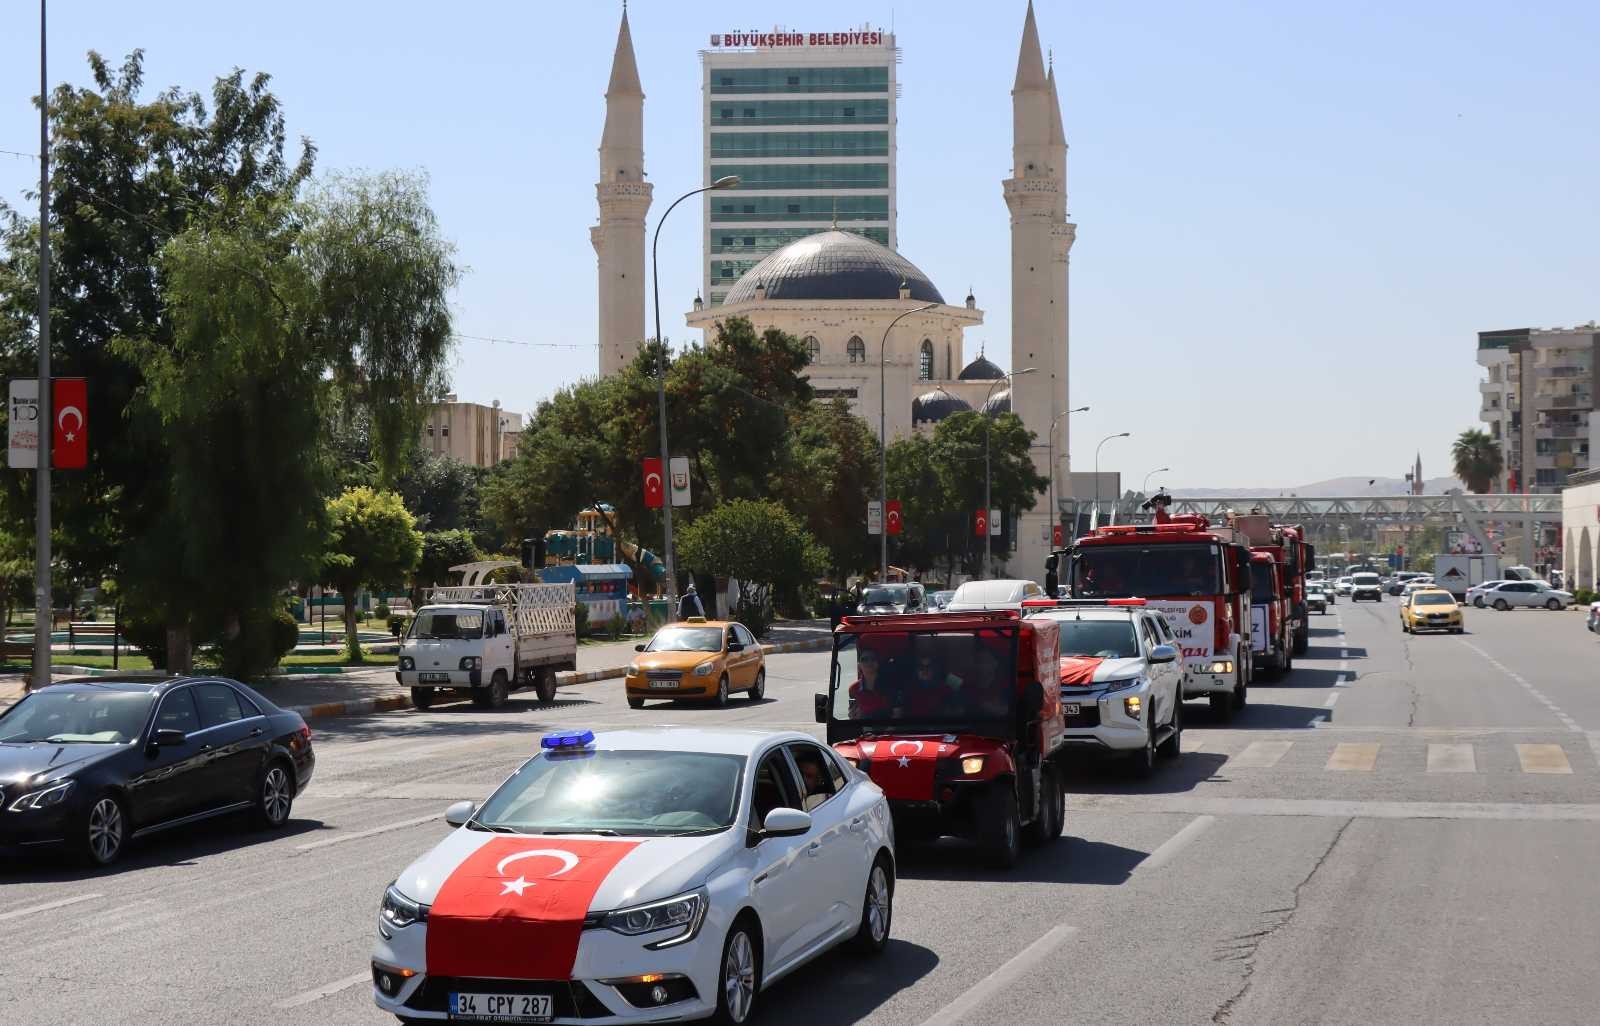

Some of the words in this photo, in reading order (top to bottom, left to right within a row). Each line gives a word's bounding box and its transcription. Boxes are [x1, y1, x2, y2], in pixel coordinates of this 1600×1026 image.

[724, 29, 804, 48] BÜYÜKŞEHİR
[809, 27, 882, 46] BELEDİYESİ
[459, 995, 477, 1014] 34
[487, 996, 515, 1015] CPY
[521, 997, 550, 1016] 287
